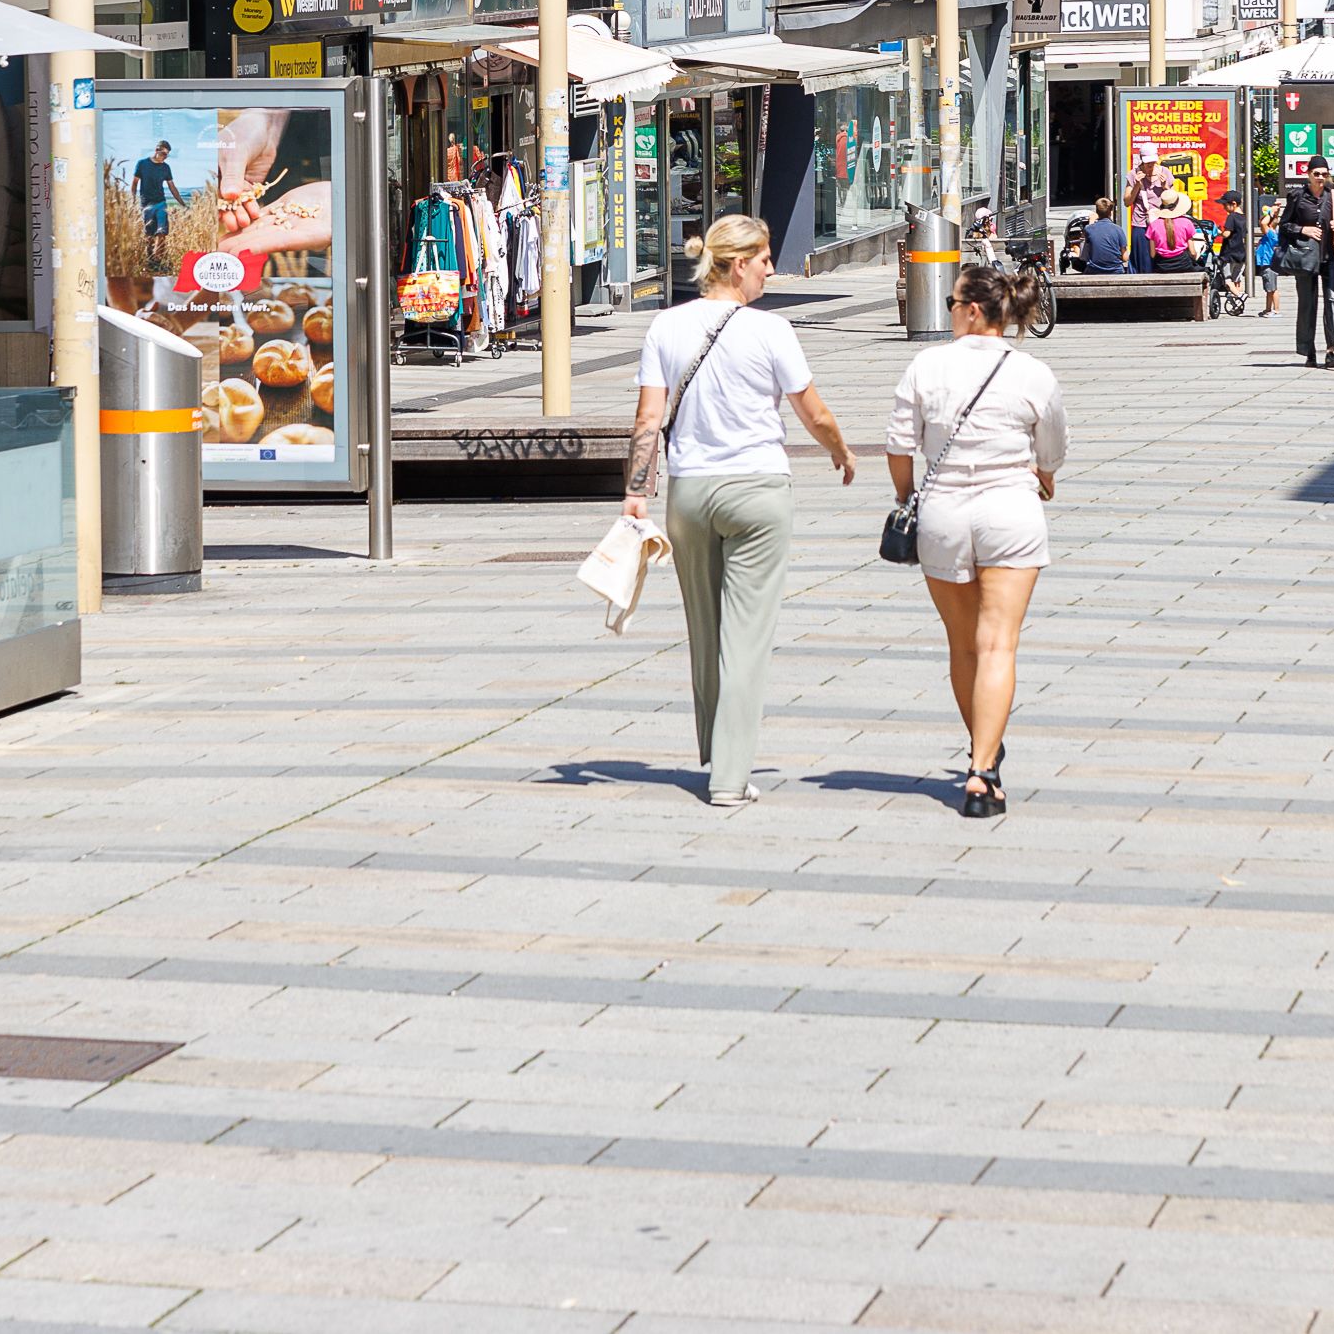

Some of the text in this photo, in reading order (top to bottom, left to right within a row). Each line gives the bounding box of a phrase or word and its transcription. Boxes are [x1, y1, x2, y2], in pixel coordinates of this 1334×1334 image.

[1061, 3, 1149, 27] ck WER
[1240, 8, 1277, 19] WERK
[274, 57, 318, 77] Money transfer
[1133, 100, 1204, 111] JETZT JEDE
[1133, 112, 1222, 122] WOCHE BIS ZU
[1168, 163, 1192, 175] ILLA
[613, 117, 625, 249] KAUFEN UHREN
[210, 262, 229, 271] AMA
[199, 271, 239, 280] GÜTESIEGEL
[167, 302, 271, 312] Das hat einen Wert.
